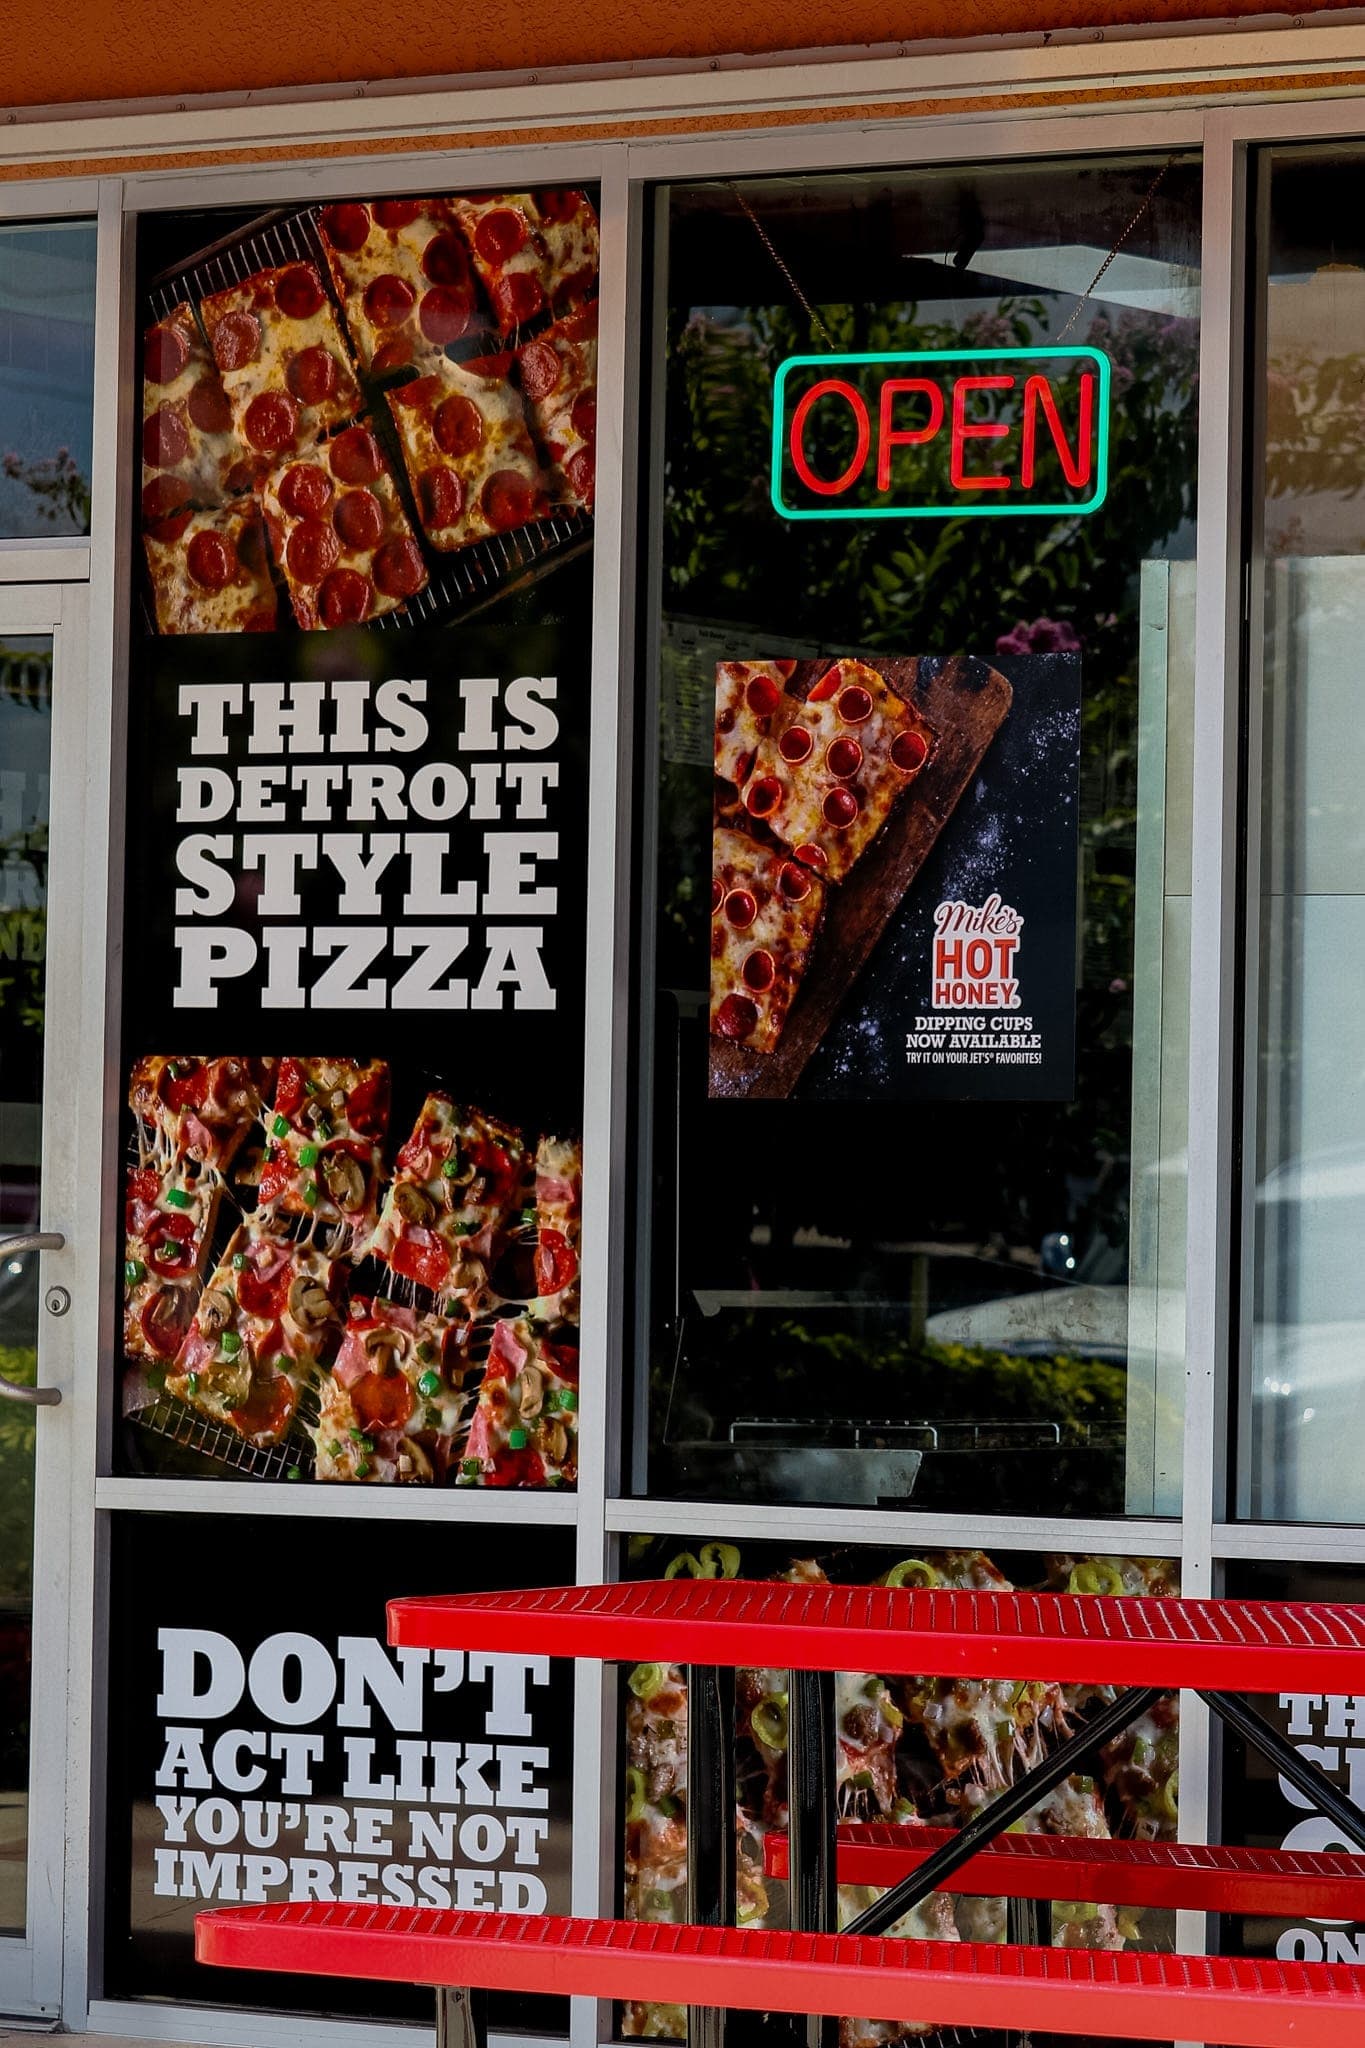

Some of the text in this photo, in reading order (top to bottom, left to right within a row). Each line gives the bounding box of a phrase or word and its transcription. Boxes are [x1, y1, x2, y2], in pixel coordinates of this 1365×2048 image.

[789, 373, 1094, 496] OPEN
[178, 676, 560, 755] THIS IS
[176, 762, 560, 823] DETROIT
[175, 831, 559, 917] STYLE
[936, 896, 1021, 935] Mike's
[173, 926, 557, 1010] PIZZA
[935, 938, 1016, 980] HOT
[935, 982, 1015, 1005] HONEY
[905, 1034, 1041, 1048] NOW AVAILABLE
[905, 1051, 922, 1064] TRY
[922, 1051, 931, 1064] IT
[932, 1051, 945, 1064] ON
[945, 1051, 968, 1064] YOUR
[995, 1051, 1042, 1064] FAVORITES!
[914, 1016, 1033, 1031] DIPPING CUPS
[156, 1627, 550, 1737] DON'T
[155, 1726, 550, 1810] ACT LIKE
[155, 1794, 549, 1866] YOU'RE NOT
[154, 1847, 548, 1917] IMPRESSED
